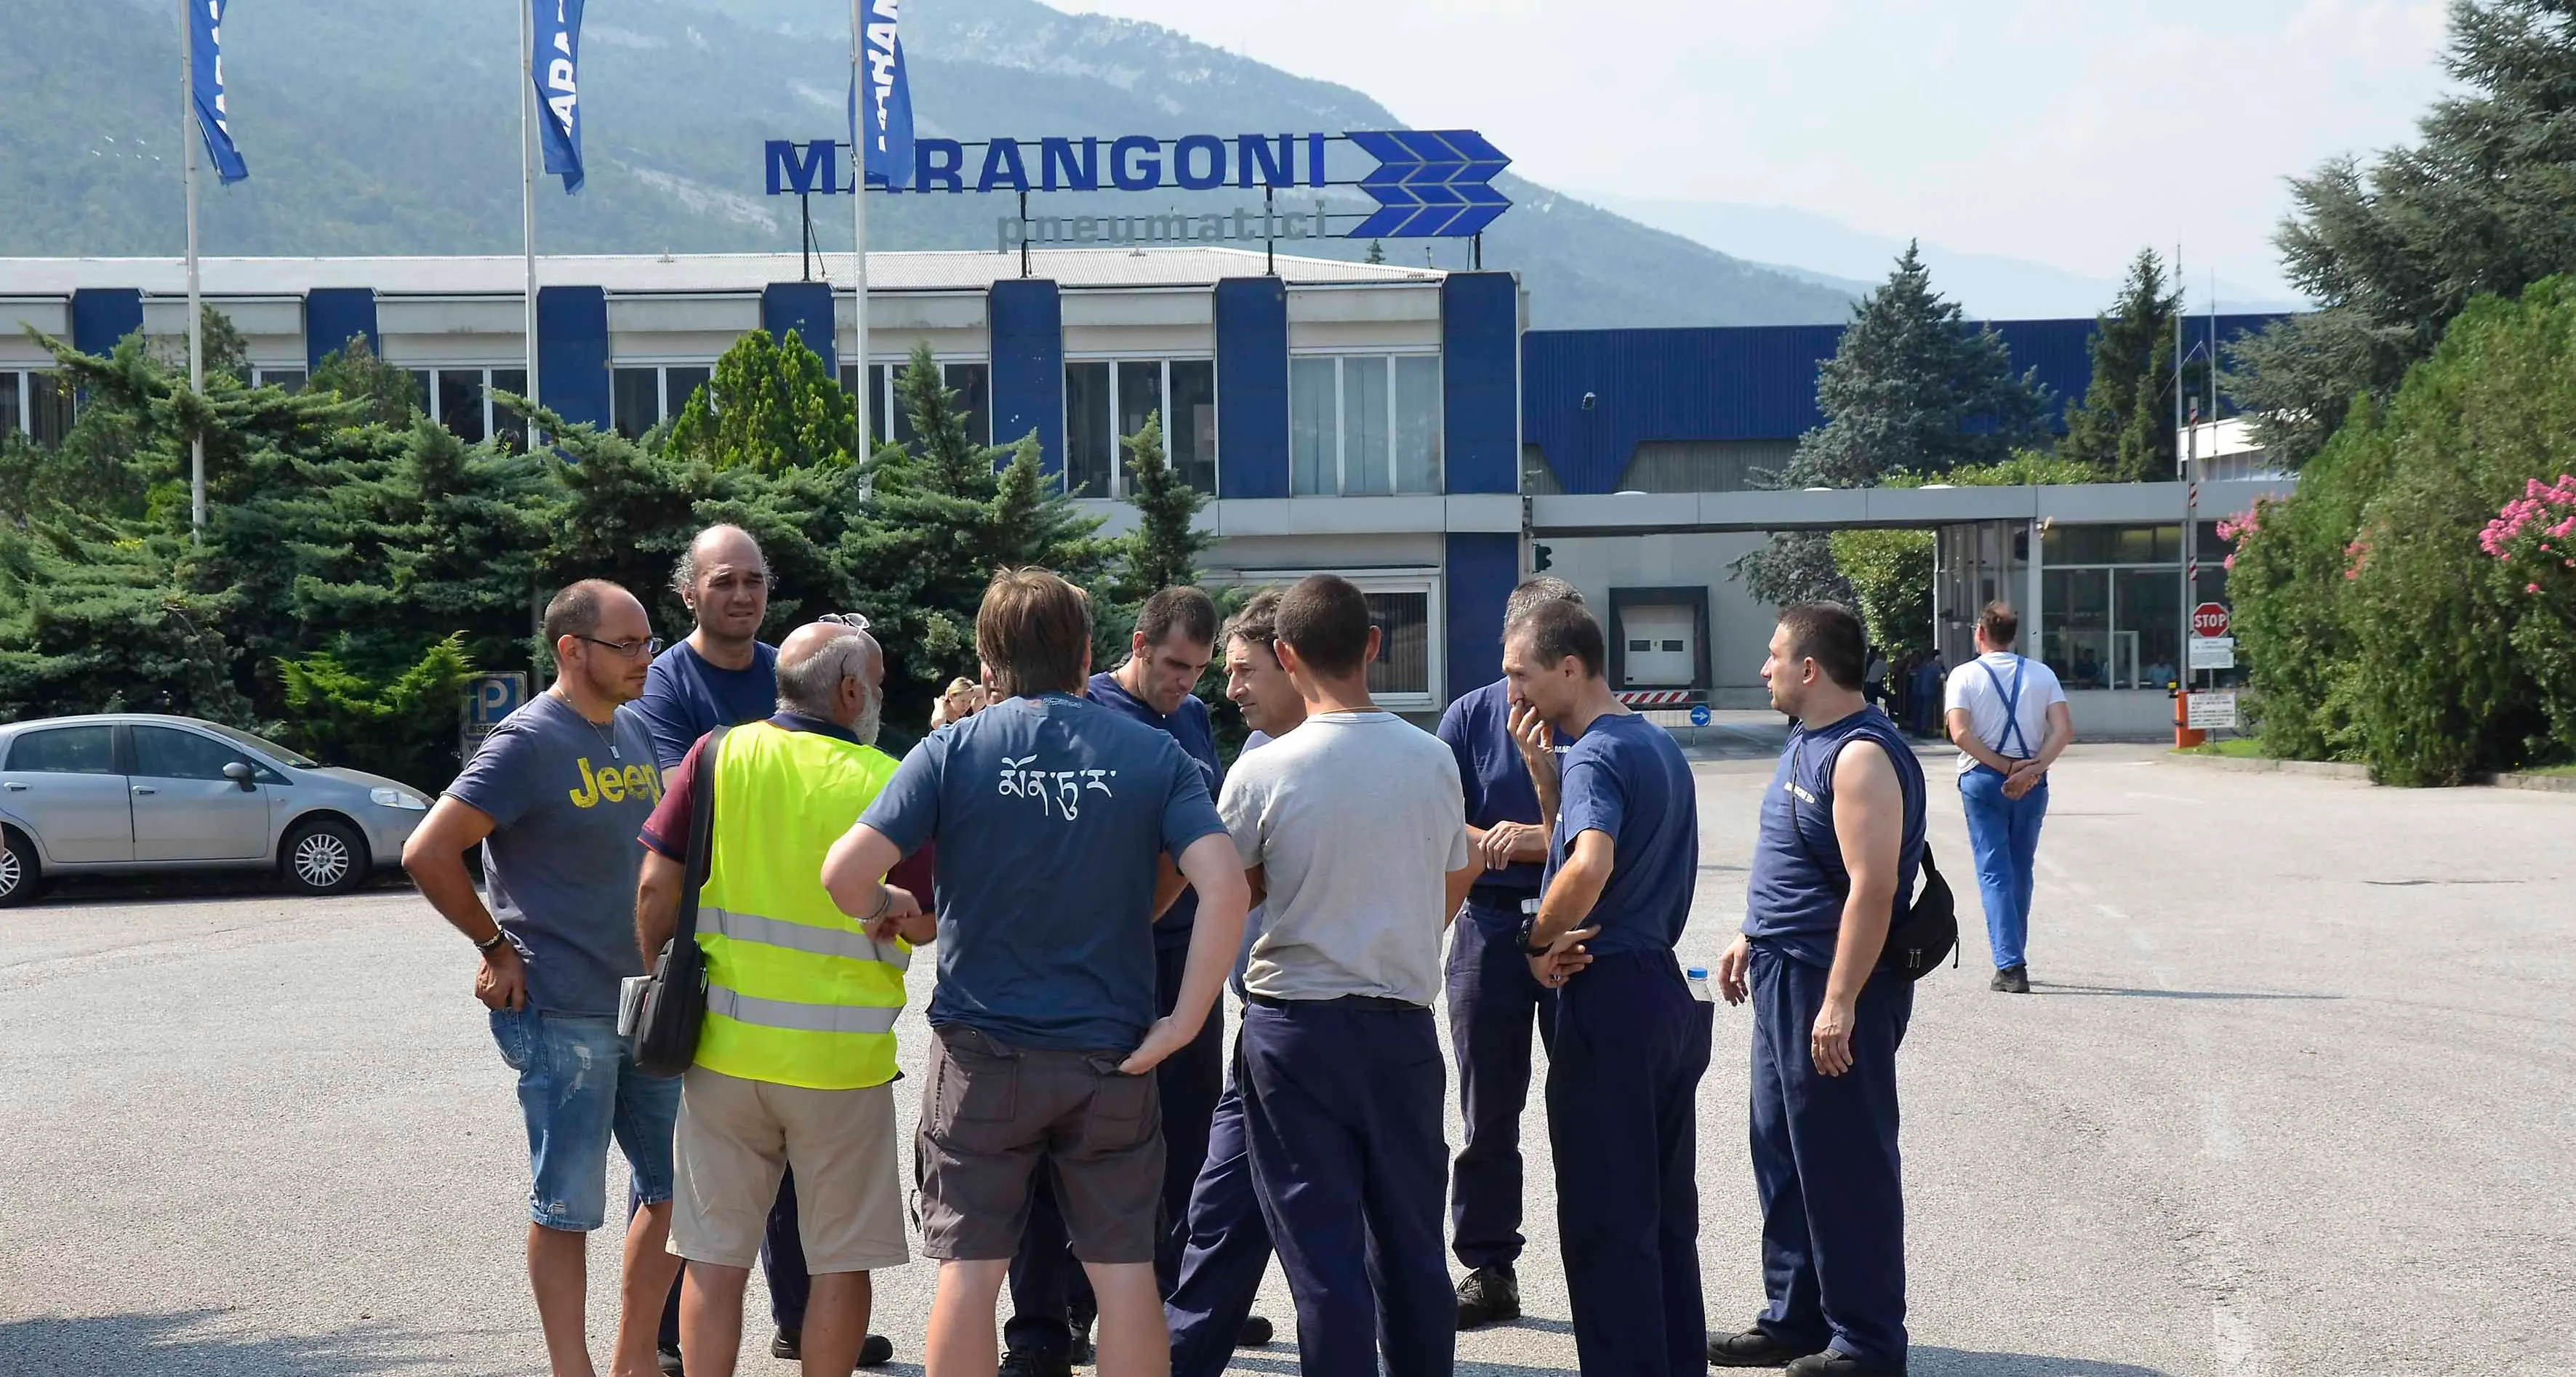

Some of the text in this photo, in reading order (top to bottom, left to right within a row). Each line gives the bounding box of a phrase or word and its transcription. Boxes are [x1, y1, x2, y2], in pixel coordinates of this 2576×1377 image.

[765, 133, 1325, 195] MRANGONI
[998, 200, 1326, 254] pneumatici
[2194, 614, 2226, 628] STOP
[478, 679, 508, 721] P
